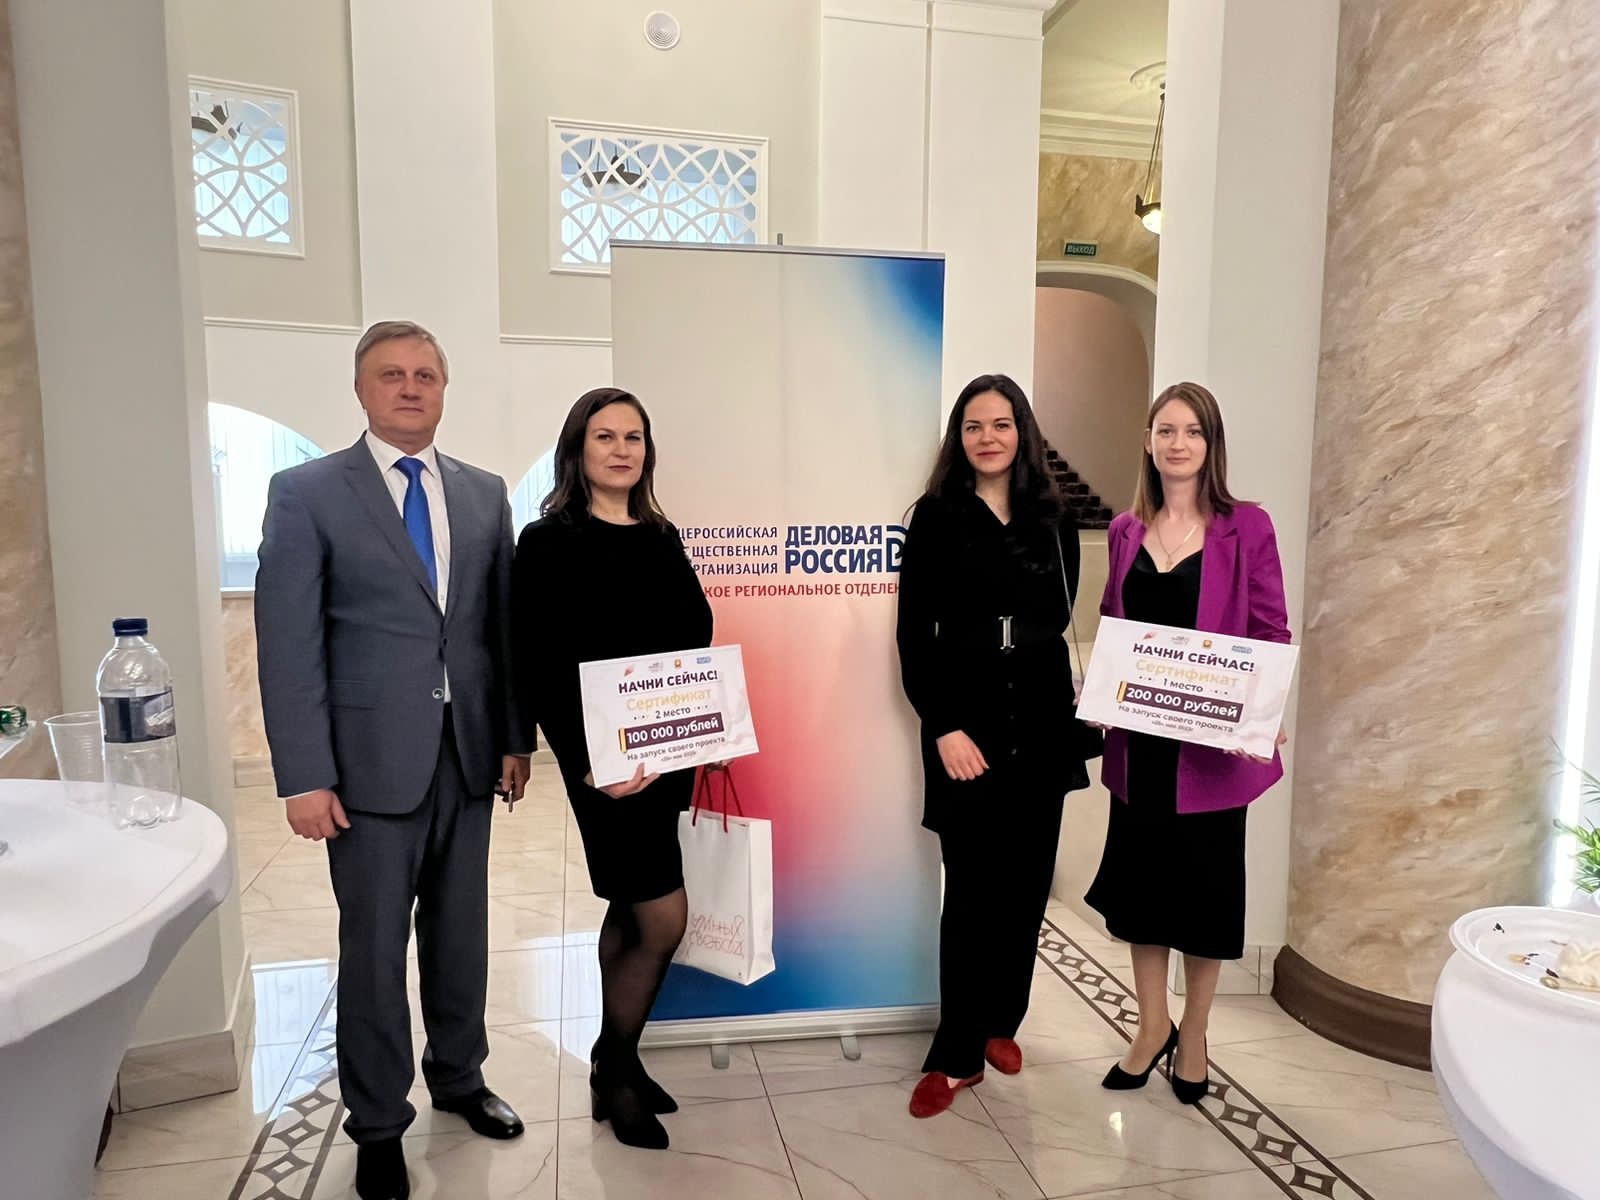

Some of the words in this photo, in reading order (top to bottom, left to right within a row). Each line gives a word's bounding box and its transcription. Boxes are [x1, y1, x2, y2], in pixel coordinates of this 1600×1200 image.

[785, 525, 882, 548] ДЕЛОВАЯ
[684, 545, 778, 559] ЩЕСТВЕННАЯ
[785, 548, 882, 574] РОССИЯ
[735, 583, 841, 598] РЕГИОНАЛЬНОЕ
[1133, 643, 1184, 661] НАЧНИ
[1188, 653, 1255, 672] СЕЙЧАС!
[618, 678, 664, 694] НАЧНИ
[667, 670, 718, 686] СЕЙЧАС!
[1136, 660, 1240, 687] Сертификат
[1163, 678, 1168, 686] 1
[1169, 680, 1204, 693] место
[626, 689, 712, 712] Сертификат
[1126, 687, 1152, 701] 200
[1154, 693, 1182, 707] 000
[1183, 700, 1239, 718] рублей
[655, 710, 661, 719] 2
[663, 707, 691, 718] место
[1118, 705, 1130, 713] На
[1131, 708, 1162, 719] запуск
[1163, 714, 1194, 726] своего
[1195, 719, 1234, 733] проекта
[626, 730, 648, 744] 100
[651, 726, 674, 740] 000
[676, 718, 719, 738] рублей
[627, 752, 638, 761] На
[640, 748, 666, 759] запуск
[668, 742, 694, 753] своего
[695, 736, 726, 749] проекта
